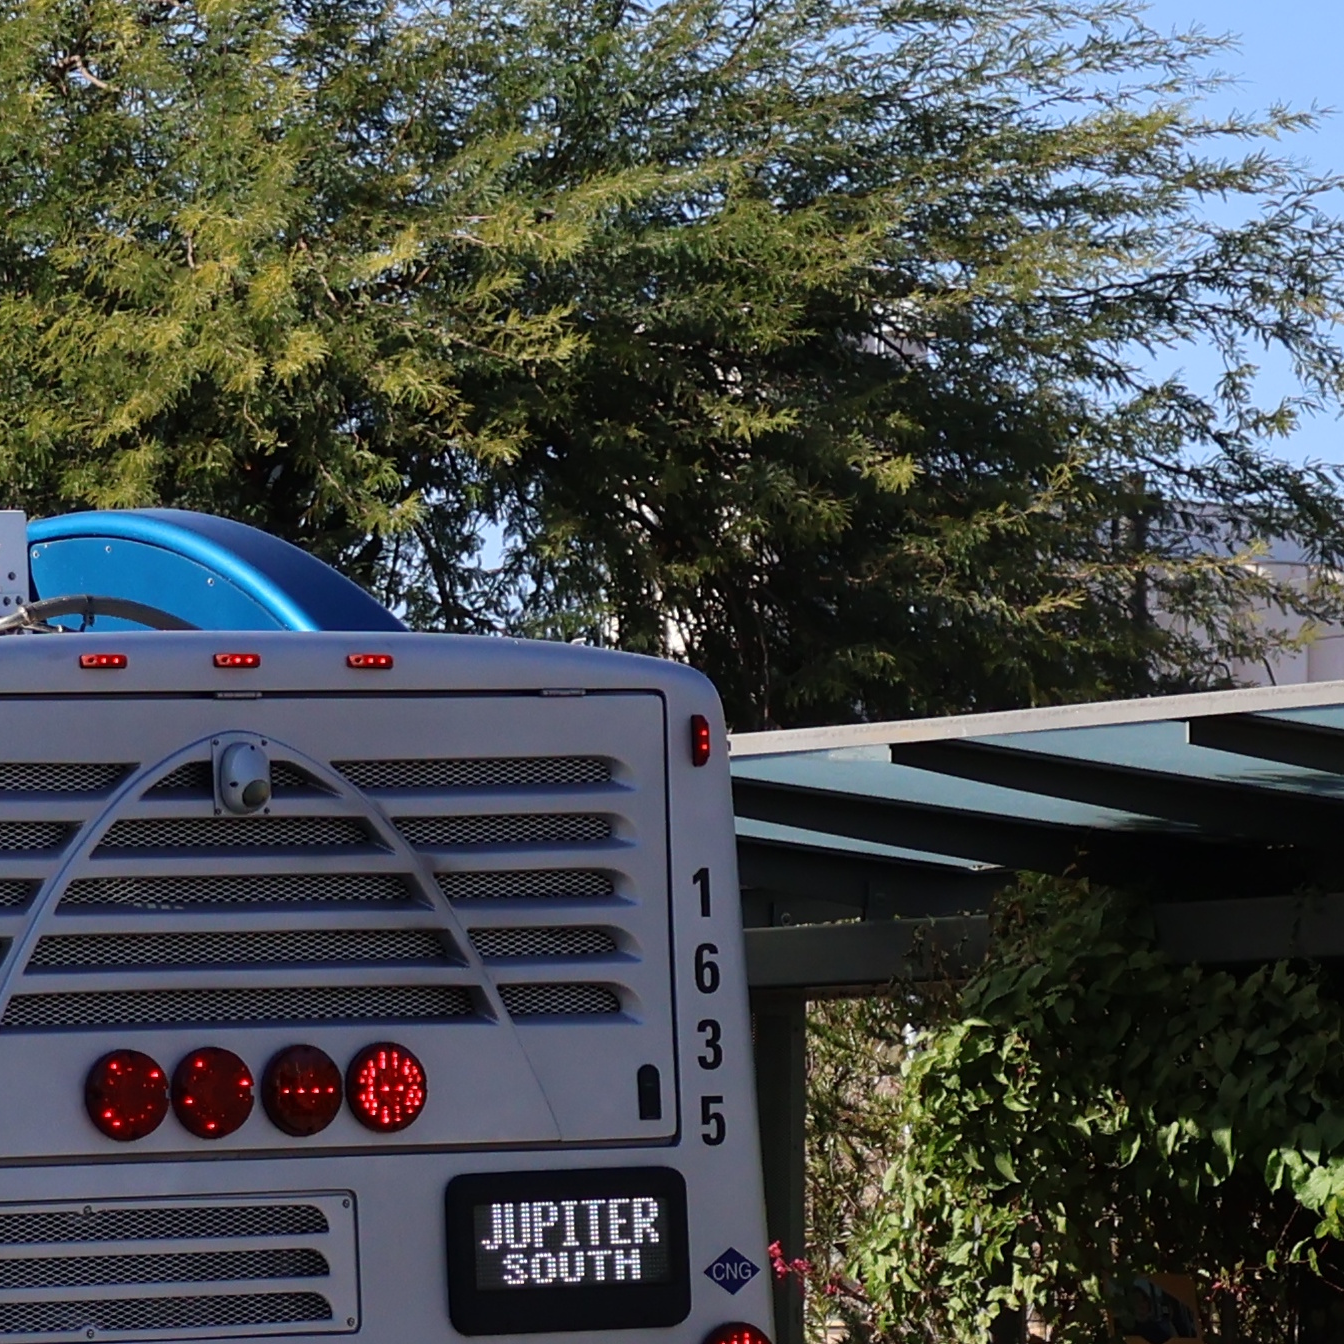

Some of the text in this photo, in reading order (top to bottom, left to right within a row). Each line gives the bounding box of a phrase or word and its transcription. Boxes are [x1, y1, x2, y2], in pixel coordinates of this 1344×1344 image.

[692, 867, 727, 1147] 1635
[481, 1197, 660, 1250] JUPITER
[502, 1249, 642, 1285] SOUTH
[712, 1261, 752, 1281] CNG
